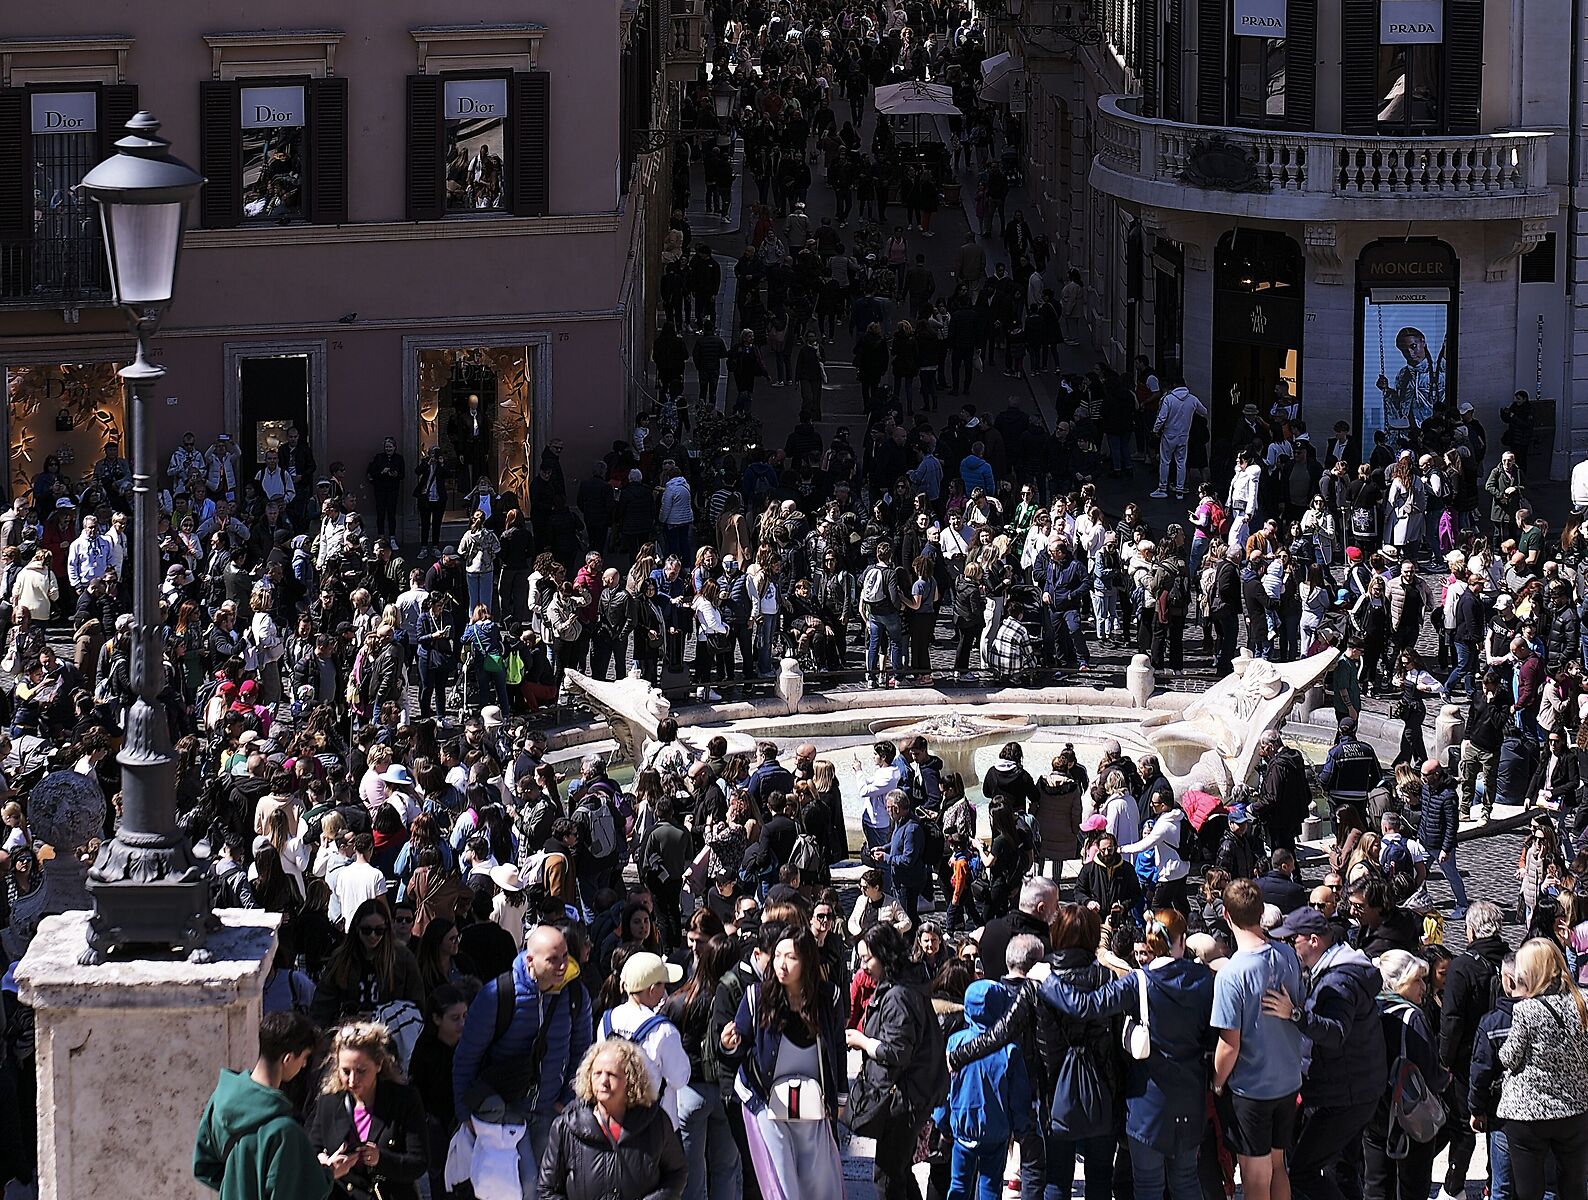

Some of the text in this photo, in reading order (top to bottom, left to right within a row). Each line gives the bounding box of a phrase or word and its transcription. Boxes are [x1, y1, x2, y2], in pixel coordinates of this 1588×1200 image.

[1241, 16, 1283, 28] PRADA
[1389, 23, 1436, 33] PRADA
[457, 97, 495, 114] Dior
[44, 111, 84, 128] Dior
[254, 105, 293, 122] Dior
[1370, 261, 1445, 274] MONCLER
[1306, 313, 1316, 322] 77
[559, 332, 569, 341] 75
[332, 341, 344, 350] 74
